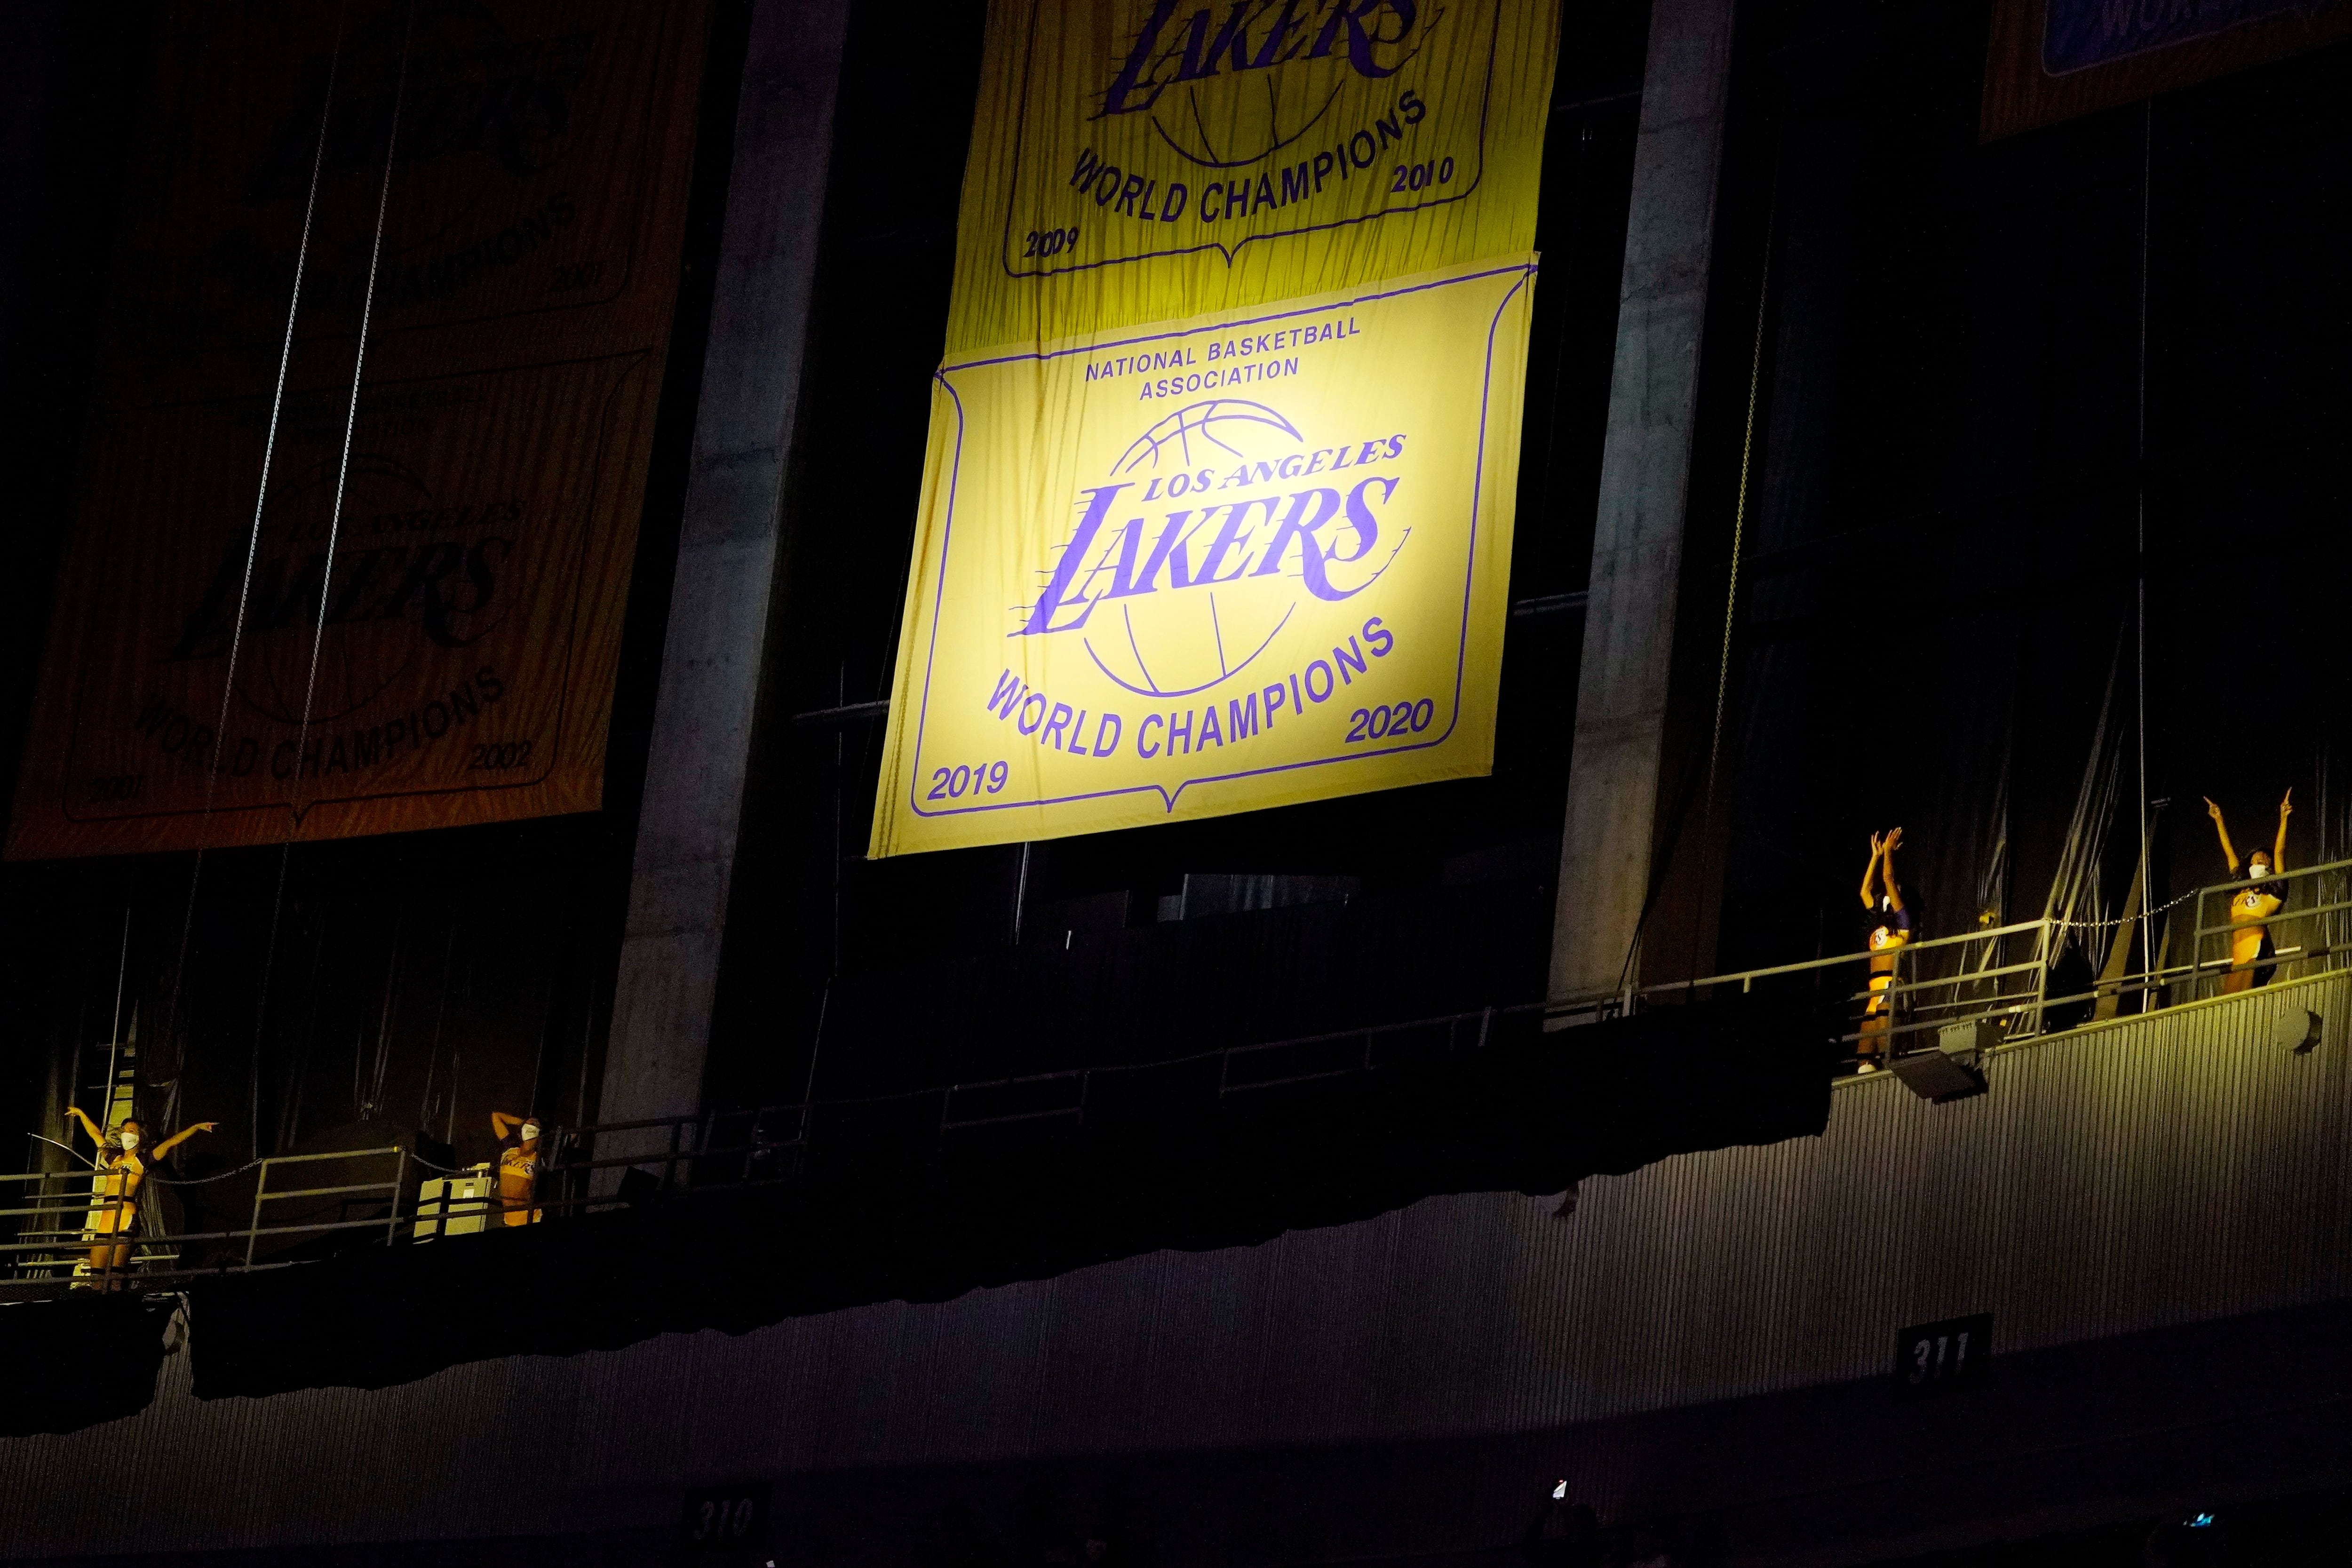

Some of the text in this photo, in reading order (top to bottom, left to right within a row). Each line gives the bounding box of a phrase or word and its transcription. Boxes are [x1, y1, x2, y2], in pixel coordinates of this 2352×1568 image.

[1068, 89, 1427, 223] WORLD CHAMPIONS
[1391, 156, 1455, 194] 2010
[1022, 228, 1079, 258] 2009
[1084, 317, 1361, 382] NATIONAL BASKETBALL
[1139, 357, 1300, 400] ASSOCIATION
[1142, 433, 1406, 502] LOS ANGELES
[1007, 476, 1410, 637] LAKERS
[152, 523, 516, 662] LAKERS
[987, 616, 1394, 759] WORLD CHAMPIONS
[271, 665, 505, 780] CHAMPIONS
[1345, 698, 1435, 743] 2020
[469, 741, 532, 772] 2002
[927, 760, 1009, 801] 2019
[1907, 1331, 1969, 1385] 311
[693, 1497, 754, 1541] 310
